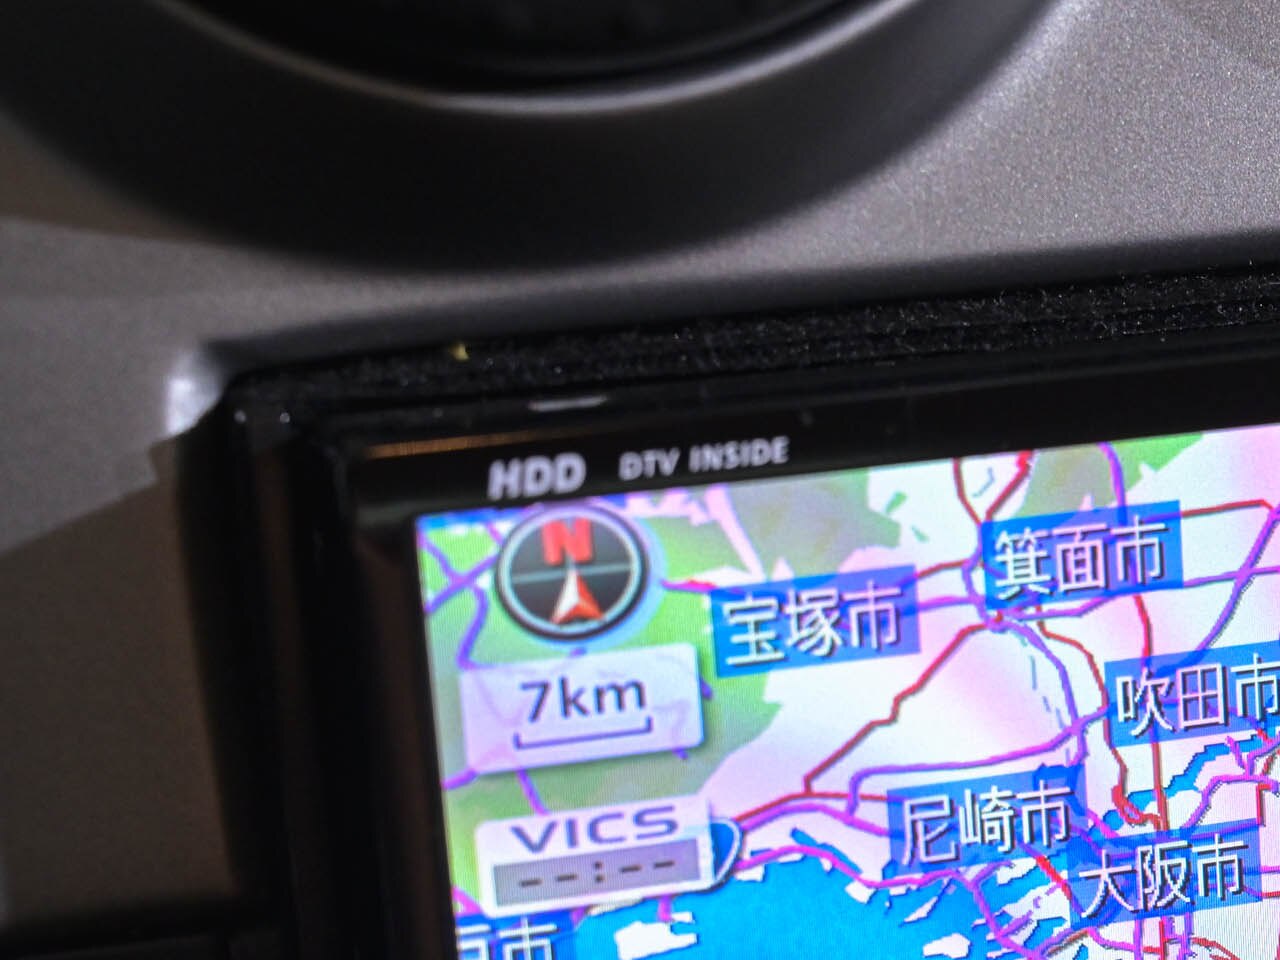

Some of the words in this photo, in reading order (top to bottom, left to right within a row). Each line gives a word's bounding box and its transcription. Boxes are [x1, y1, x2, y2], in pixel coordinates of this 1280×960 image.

[488, 452, 586, 498] HDD
[618, 451, 679, 480] DTV
[688, 436, 789, 472] INSIDE
[994, 514, 1167, 602] 箕面市
[722, 580, 902, 666] 宝塚市
[519, 675, 646, 724] 7km
[510, 804, 679, 854] VICS
[902, 779, 1072, 867] 尼崎市
[1079, 832, 1248, 915] 大阪市
